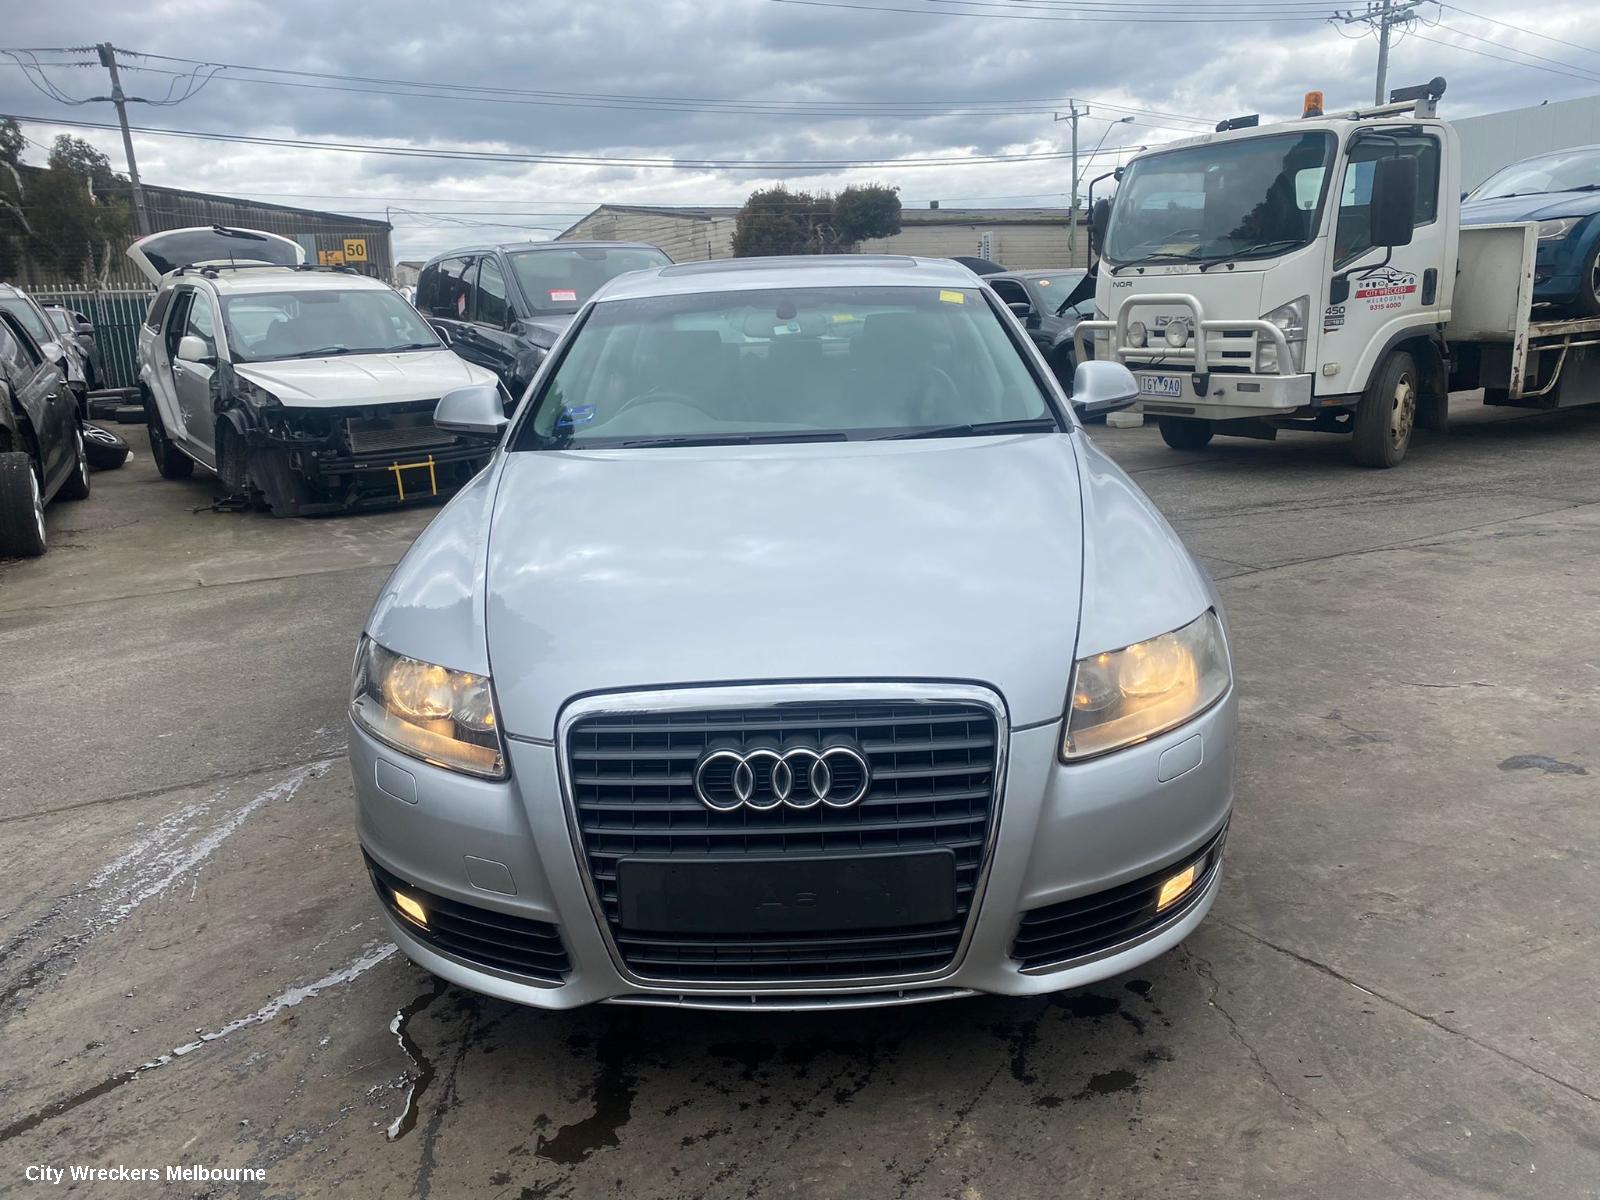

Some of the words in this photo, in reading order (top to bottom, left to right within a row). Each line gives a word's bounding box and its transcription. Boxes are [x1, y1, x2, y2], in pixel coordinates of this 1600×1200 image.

[347, 244, 364, 256] 50
[1365, 289, 1378, 297] CITY
[1379, 287, 1407, 295] WRECKERS
[1366, 295, 1405, 303] MELBOURNE
[1325, 306, 1345, 314] 450
